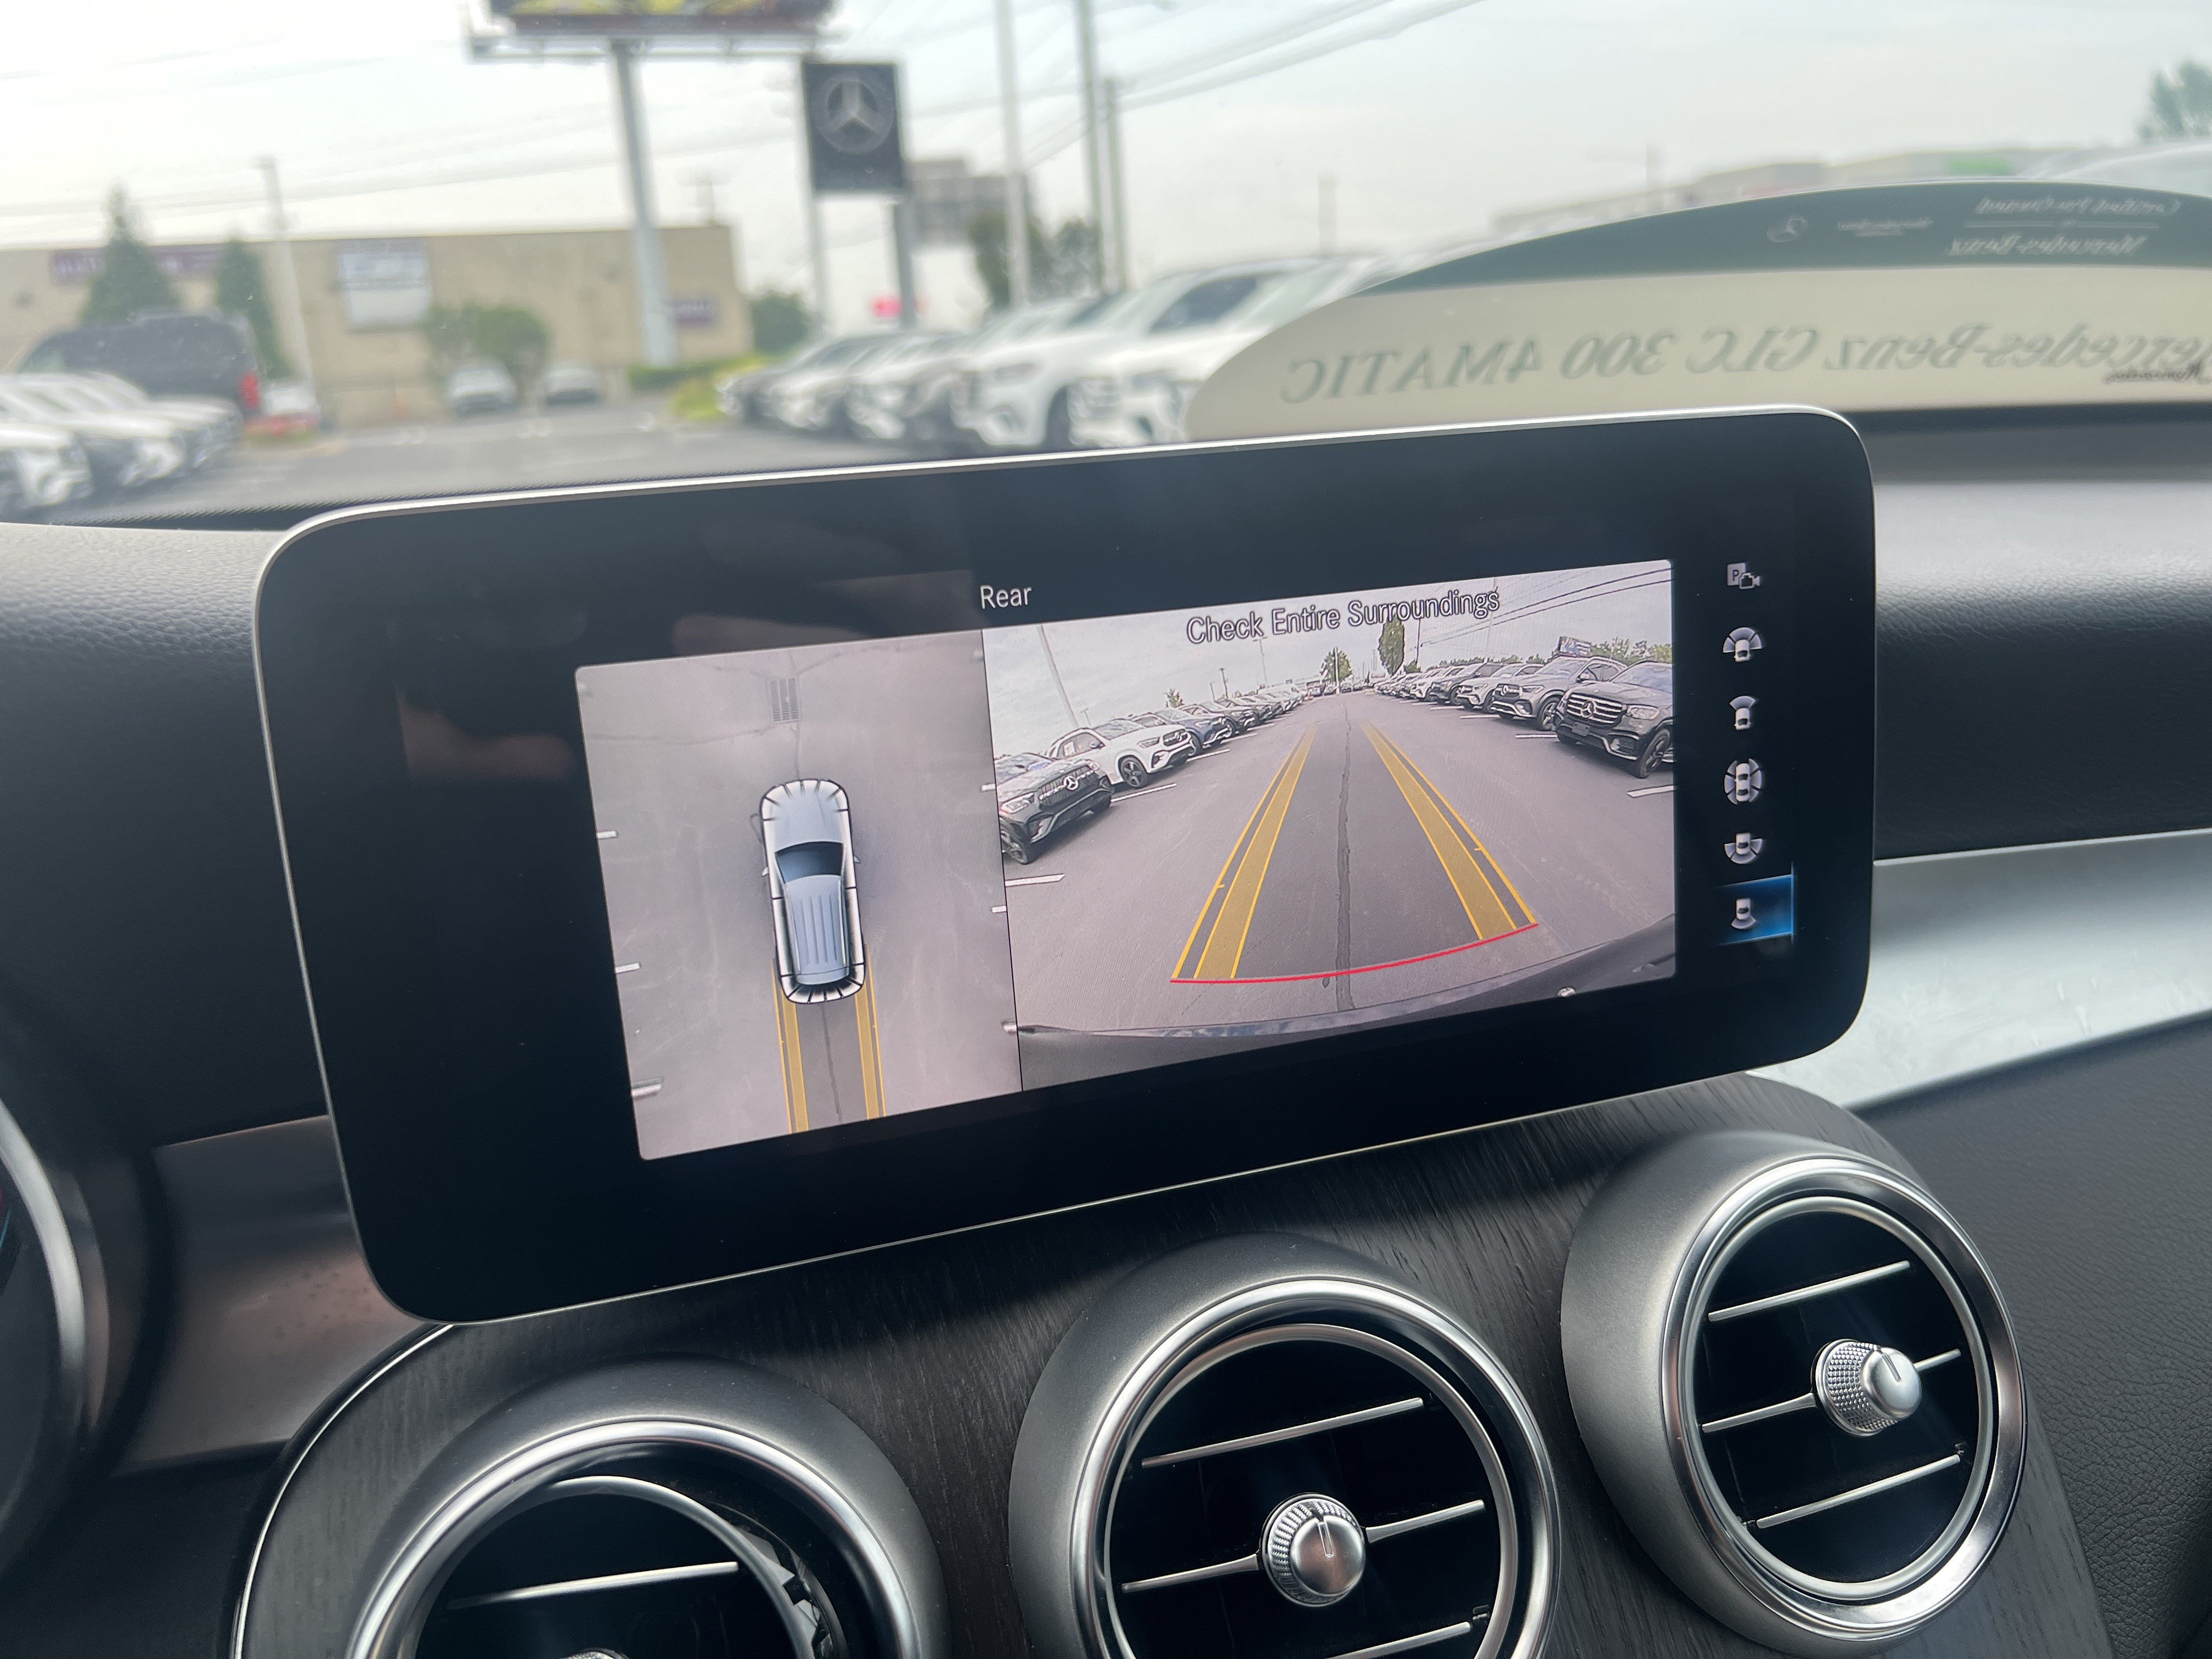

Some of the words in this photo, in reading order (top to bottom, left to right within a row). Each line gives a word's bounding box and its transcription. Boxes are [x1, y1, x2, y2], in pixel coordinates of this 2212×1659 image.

[980, 585, 1032, 610] Rear
[1186, 612, 1264, 645] Check
[1271, 605, 1340, 636] Entire
[1347, 586, 1501, 627] Surroundings
